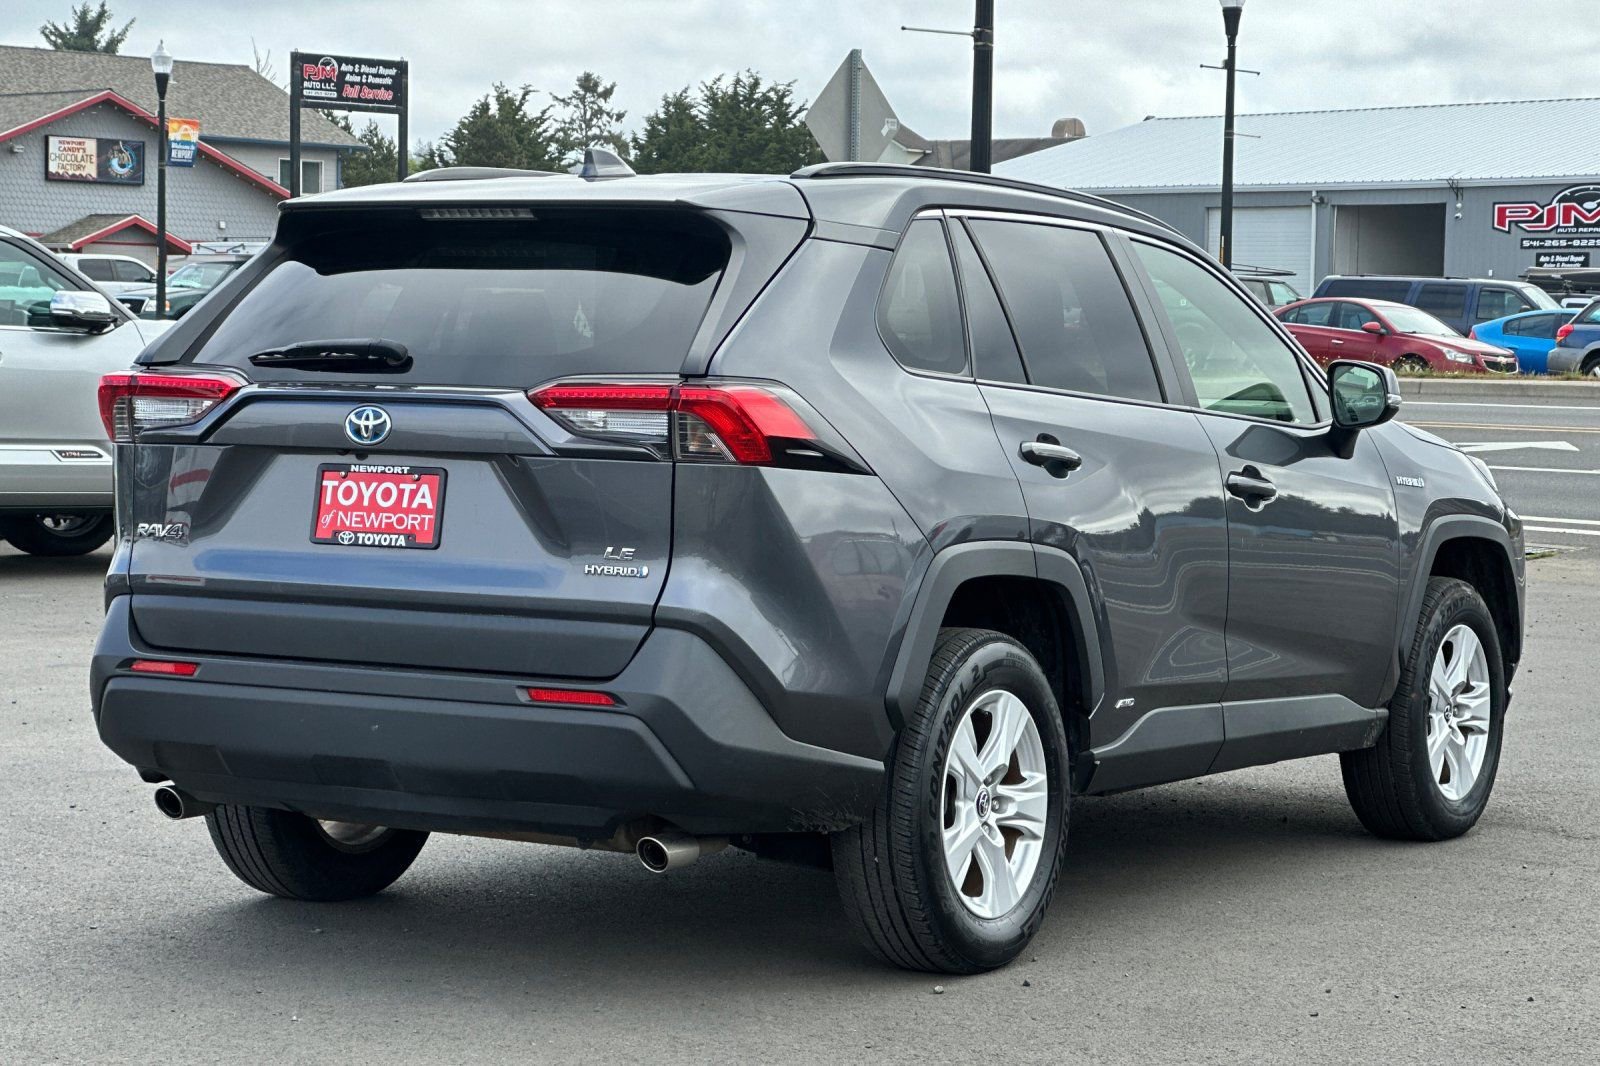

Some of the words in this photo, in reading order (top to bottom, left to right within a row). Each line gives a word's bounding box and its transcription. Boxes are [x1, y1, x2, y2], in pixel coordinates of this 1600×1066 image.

[303, 63, 336, 81] PJM
[341, 63, 354, 72] Auto
[354, 64, 359, 72] &
[360, 65, 378, 74] Diesel
[378, 66, 397, 76] Repair
[362, 75, 367, 83] &
[368, 75, 393, 85] Domestic
[343, 84, 360, 99] Full
[360, 85, 394, 101] Service
[49, 152, 95, 164] CHOCOLATE
[57, 163, 87, 172] FACTORY
[350, 464, 411, 474] NEWPORT
[322, 480, 434, 509] TOYOTA
[321, 509, 337, 529] of
[337, 511, 434, 531] NEWPORT
[137, 522, 183, 539] RAV4
[356, 533, 407, 547] TOYOTA
[603, 546, 636, 560] LE
[584, 564, 638, 577] HYBRID
[928, 681, 968, 822] CONTROL
[971, 664, 981, 682] 2
